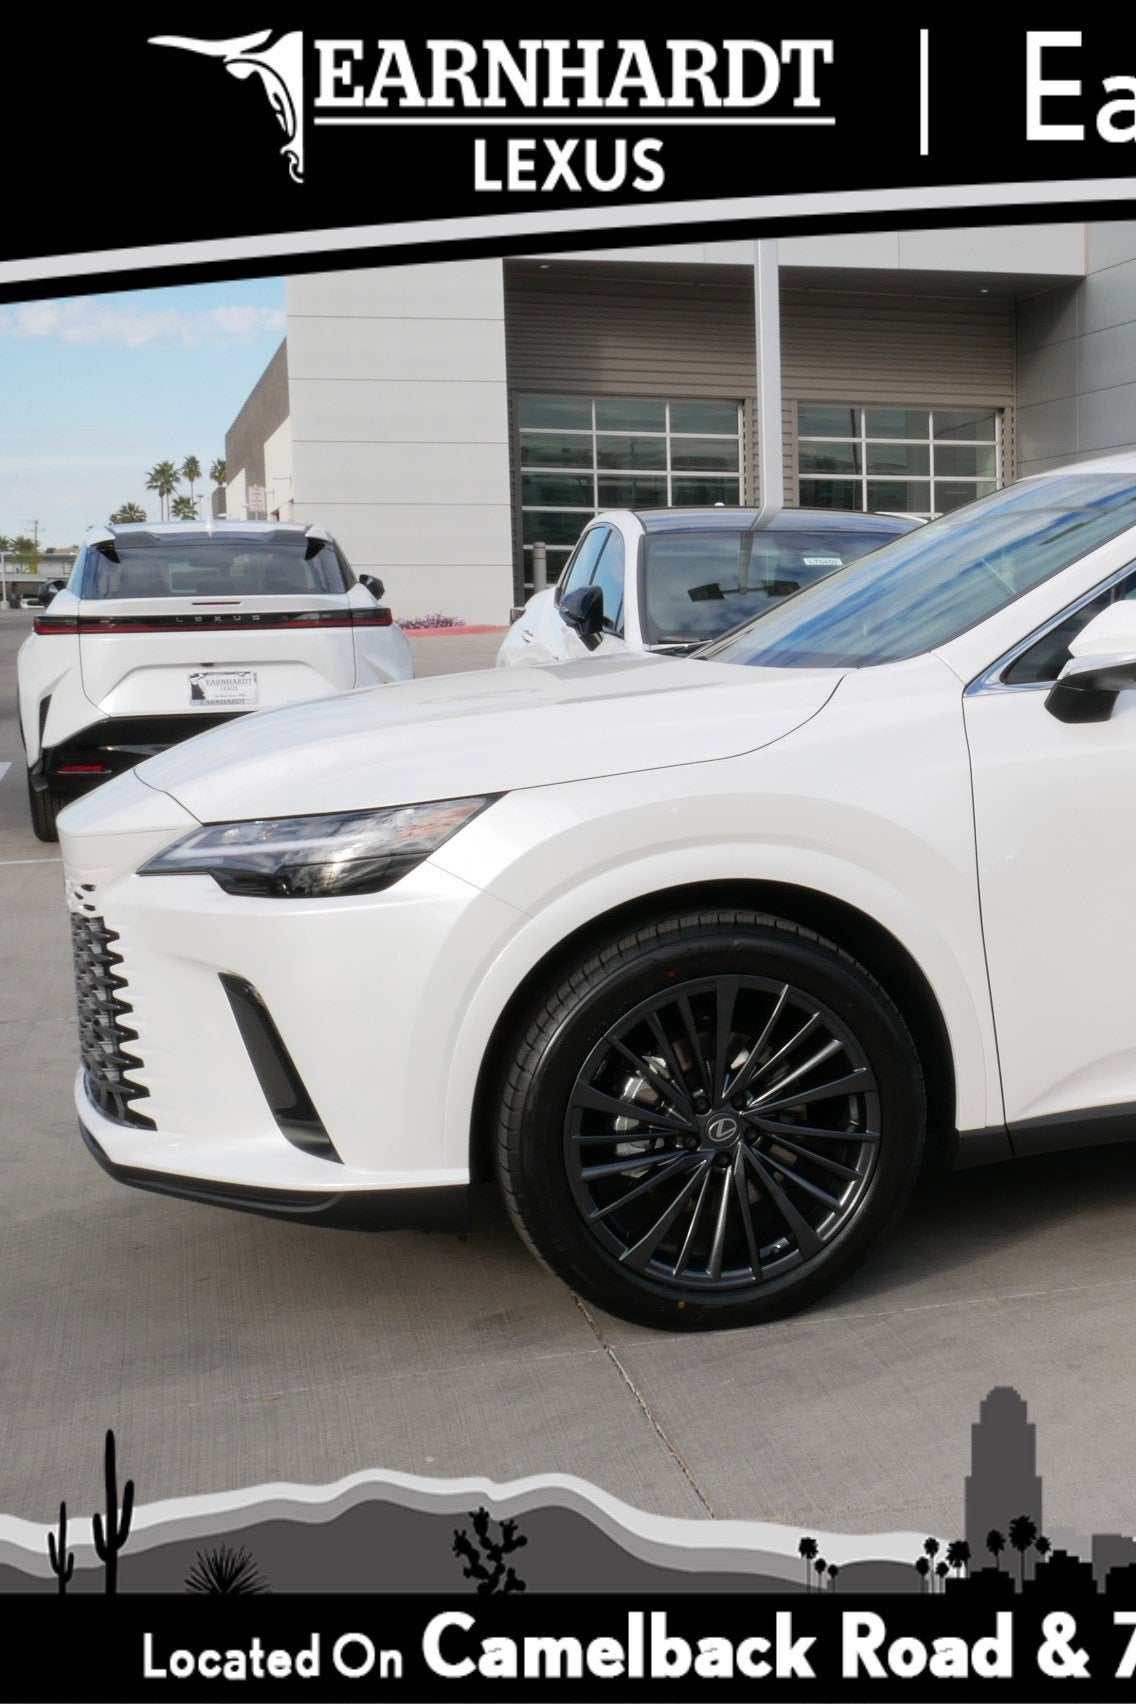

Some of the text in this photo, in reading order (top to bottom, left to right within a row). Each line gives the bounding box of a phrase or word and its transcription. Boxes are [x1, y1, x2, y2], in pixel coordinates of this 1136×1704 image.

[175, 614, 260, 623] LEXUS
[206, 678, 252, 686] EARNHARDT
[200, 698, 246, 706] EARNHARDT
